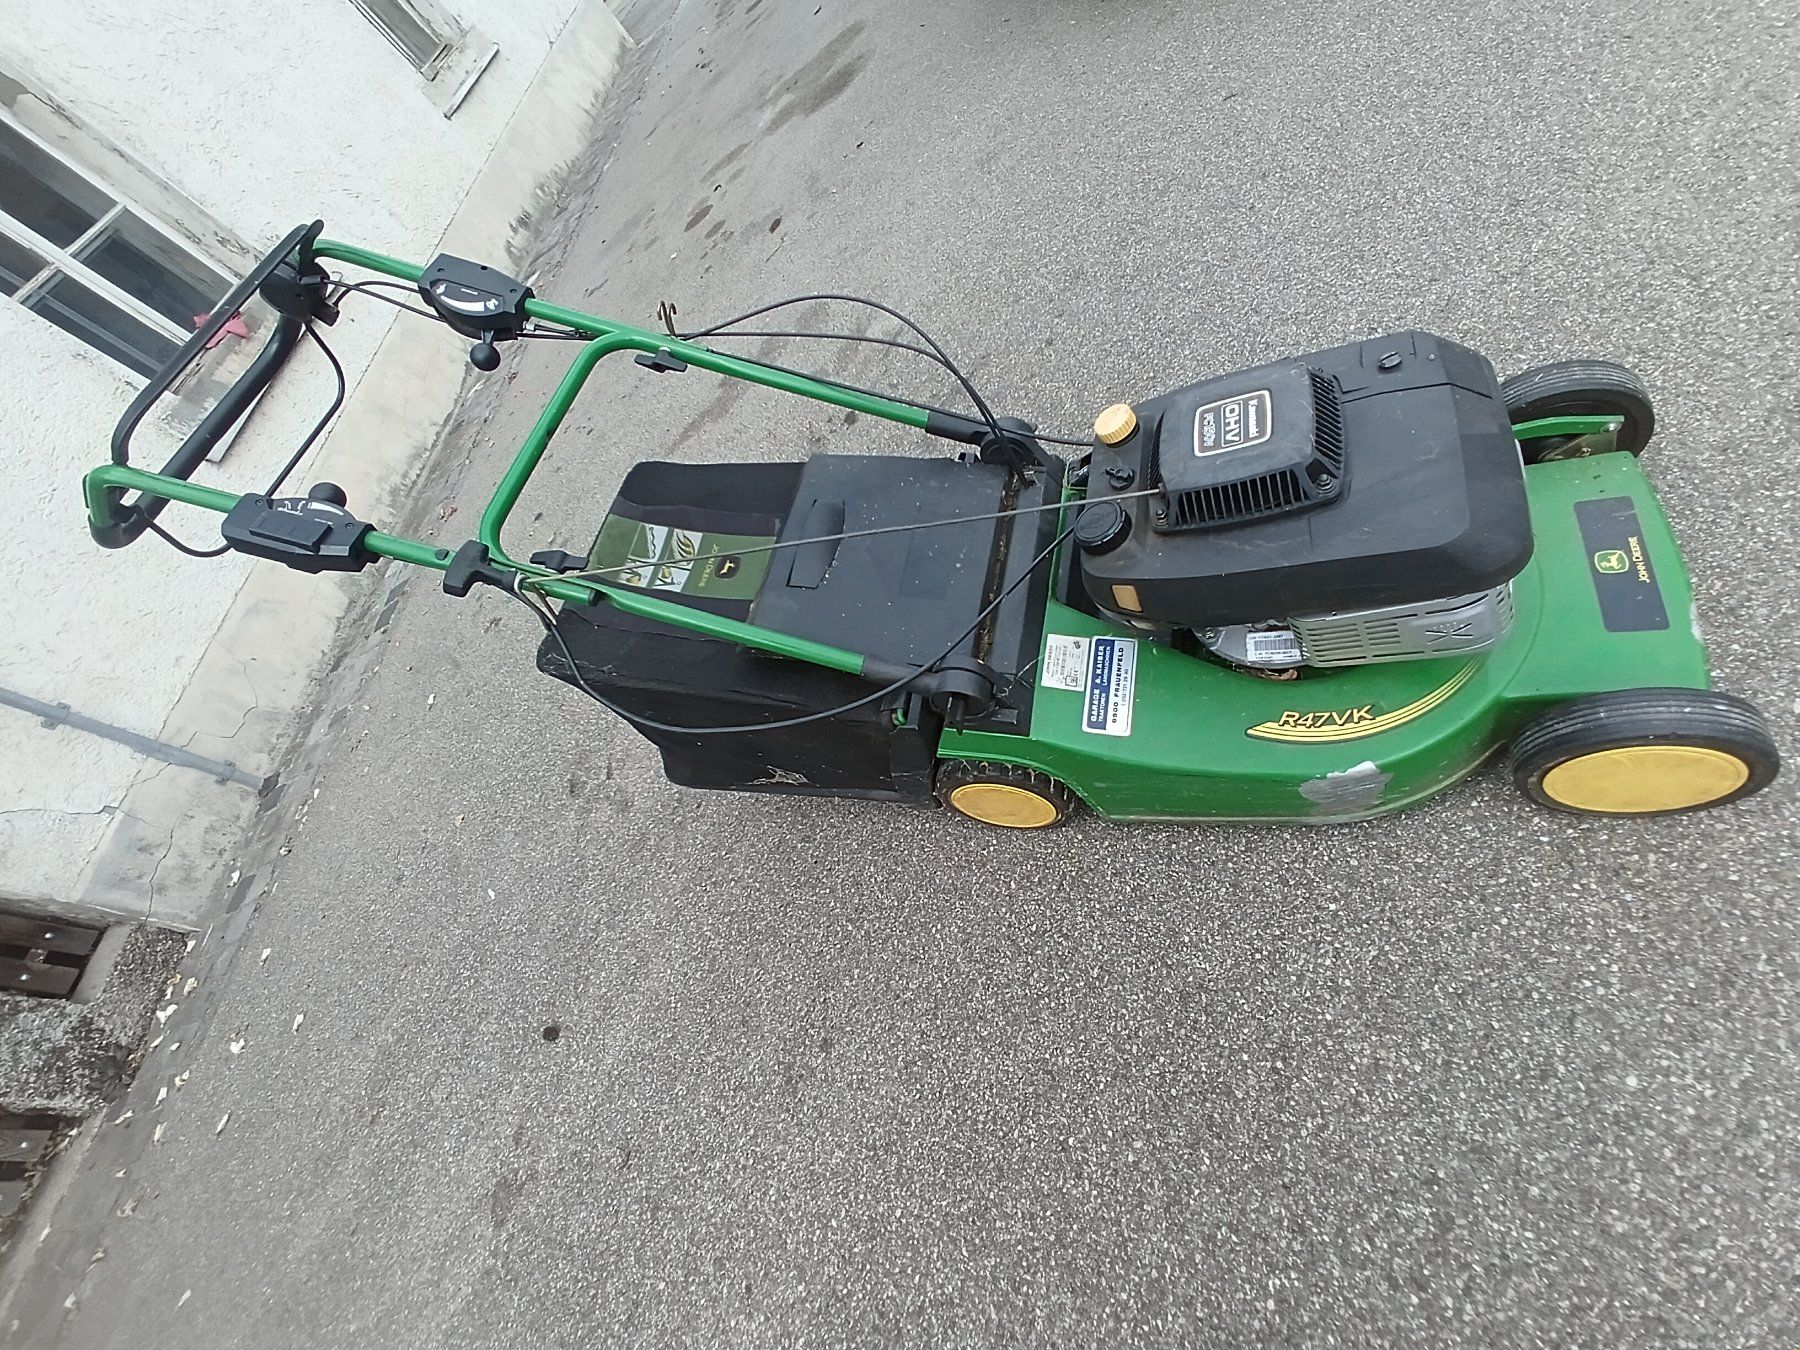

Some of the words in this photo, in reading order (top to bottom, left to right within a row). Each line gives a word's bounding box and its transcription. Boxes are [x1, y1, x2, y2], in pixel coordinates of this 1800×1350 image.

[1225, 404, 1240, 441] OHV
[1628, 536, 1643, 562] DEERE
[1635, 562, 1650, 583] JOHN
[1090, 689, 1100, 722] GARAGE
[1095, 645, 1105, 674] KAISER
[1113, 647, 1124, 698] FRAUENFELD
[1278, 704, 1375, 729] R47VK
